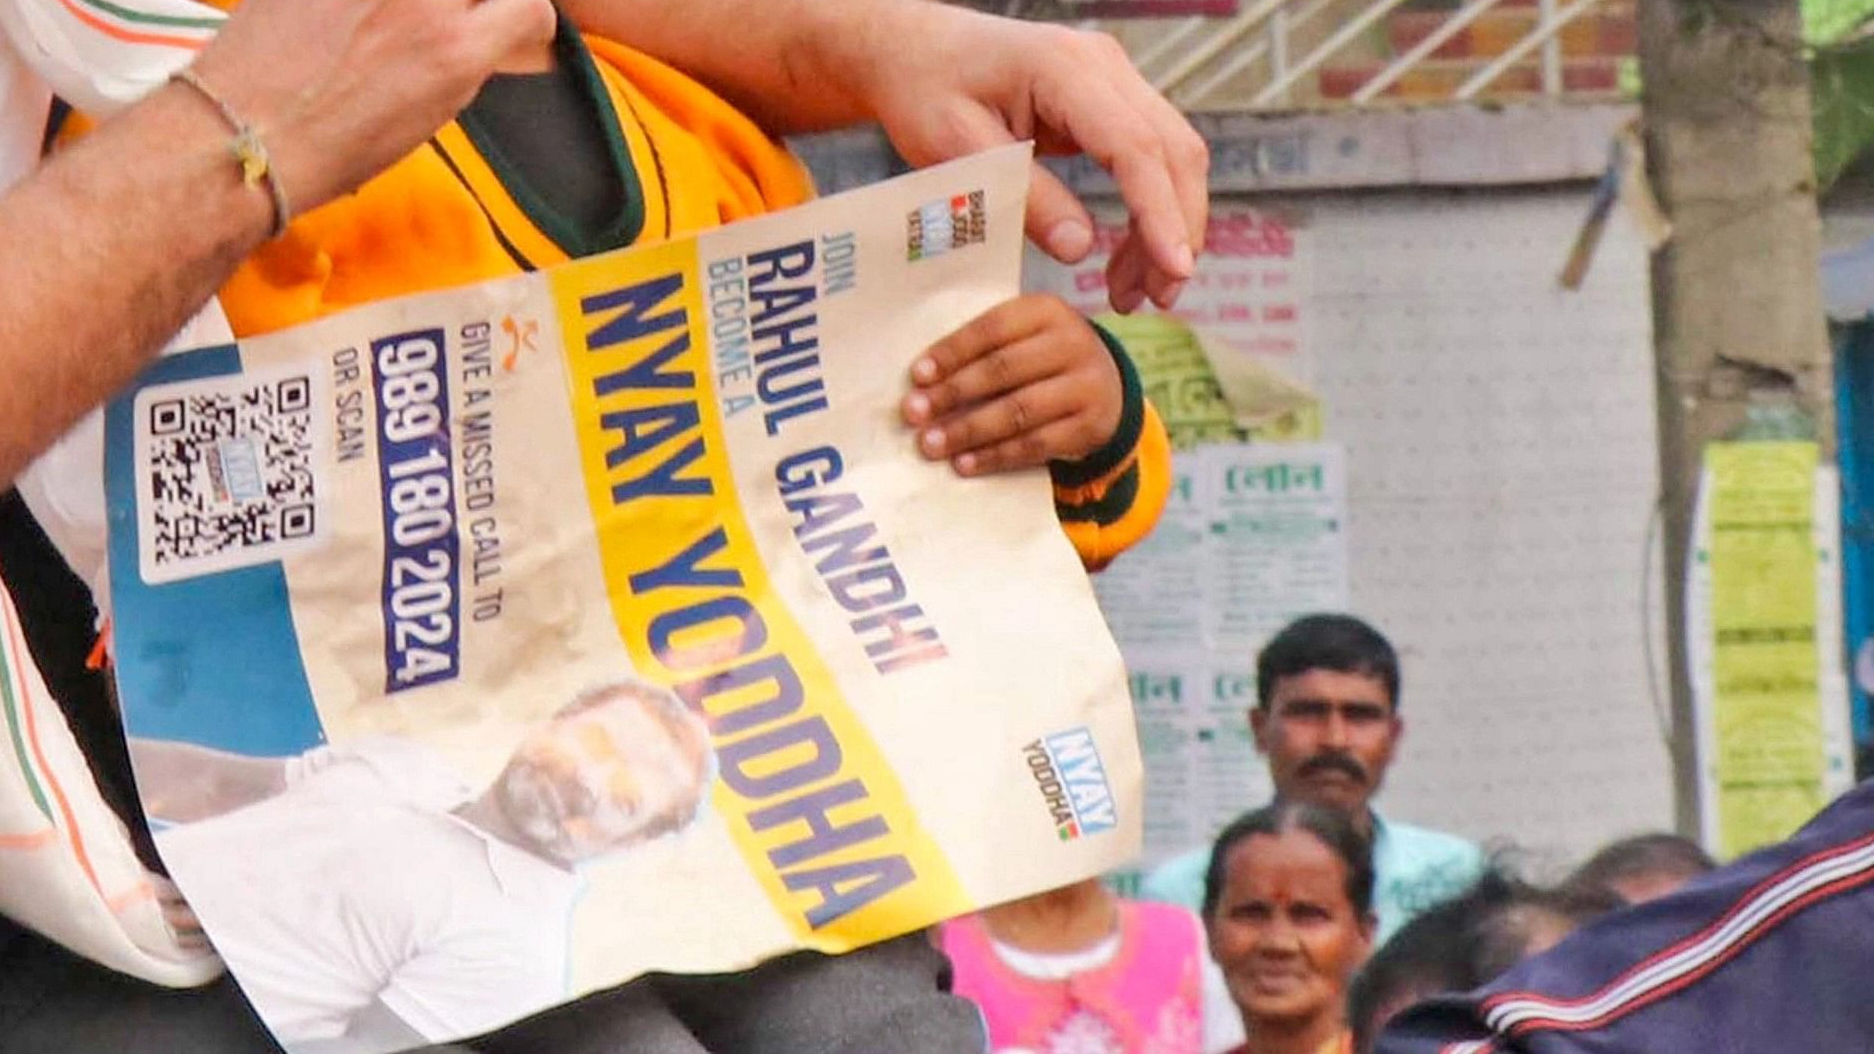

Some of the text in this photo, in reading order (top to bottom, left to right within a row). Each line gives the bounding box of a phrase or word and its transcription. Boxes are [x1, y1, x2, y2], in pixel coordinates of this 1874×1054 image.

[709, 257, 757, 419] BECOME A
[822, 231, 855, 296] JOIN
[333, 347, 365, 463] OR SCAN
[461, 322, 504, 623] GIVE A MISSED CALL TO
[747, 239, 950, 676] RAHUL GANDHI
[378, 339, 454, 685] 989 180 2024
[579, 271, 918, 931] NYAY YODDHA
[1022, 739, 1073, 826] YODDHA
[1048, 729, 1117, 833] NYAY
